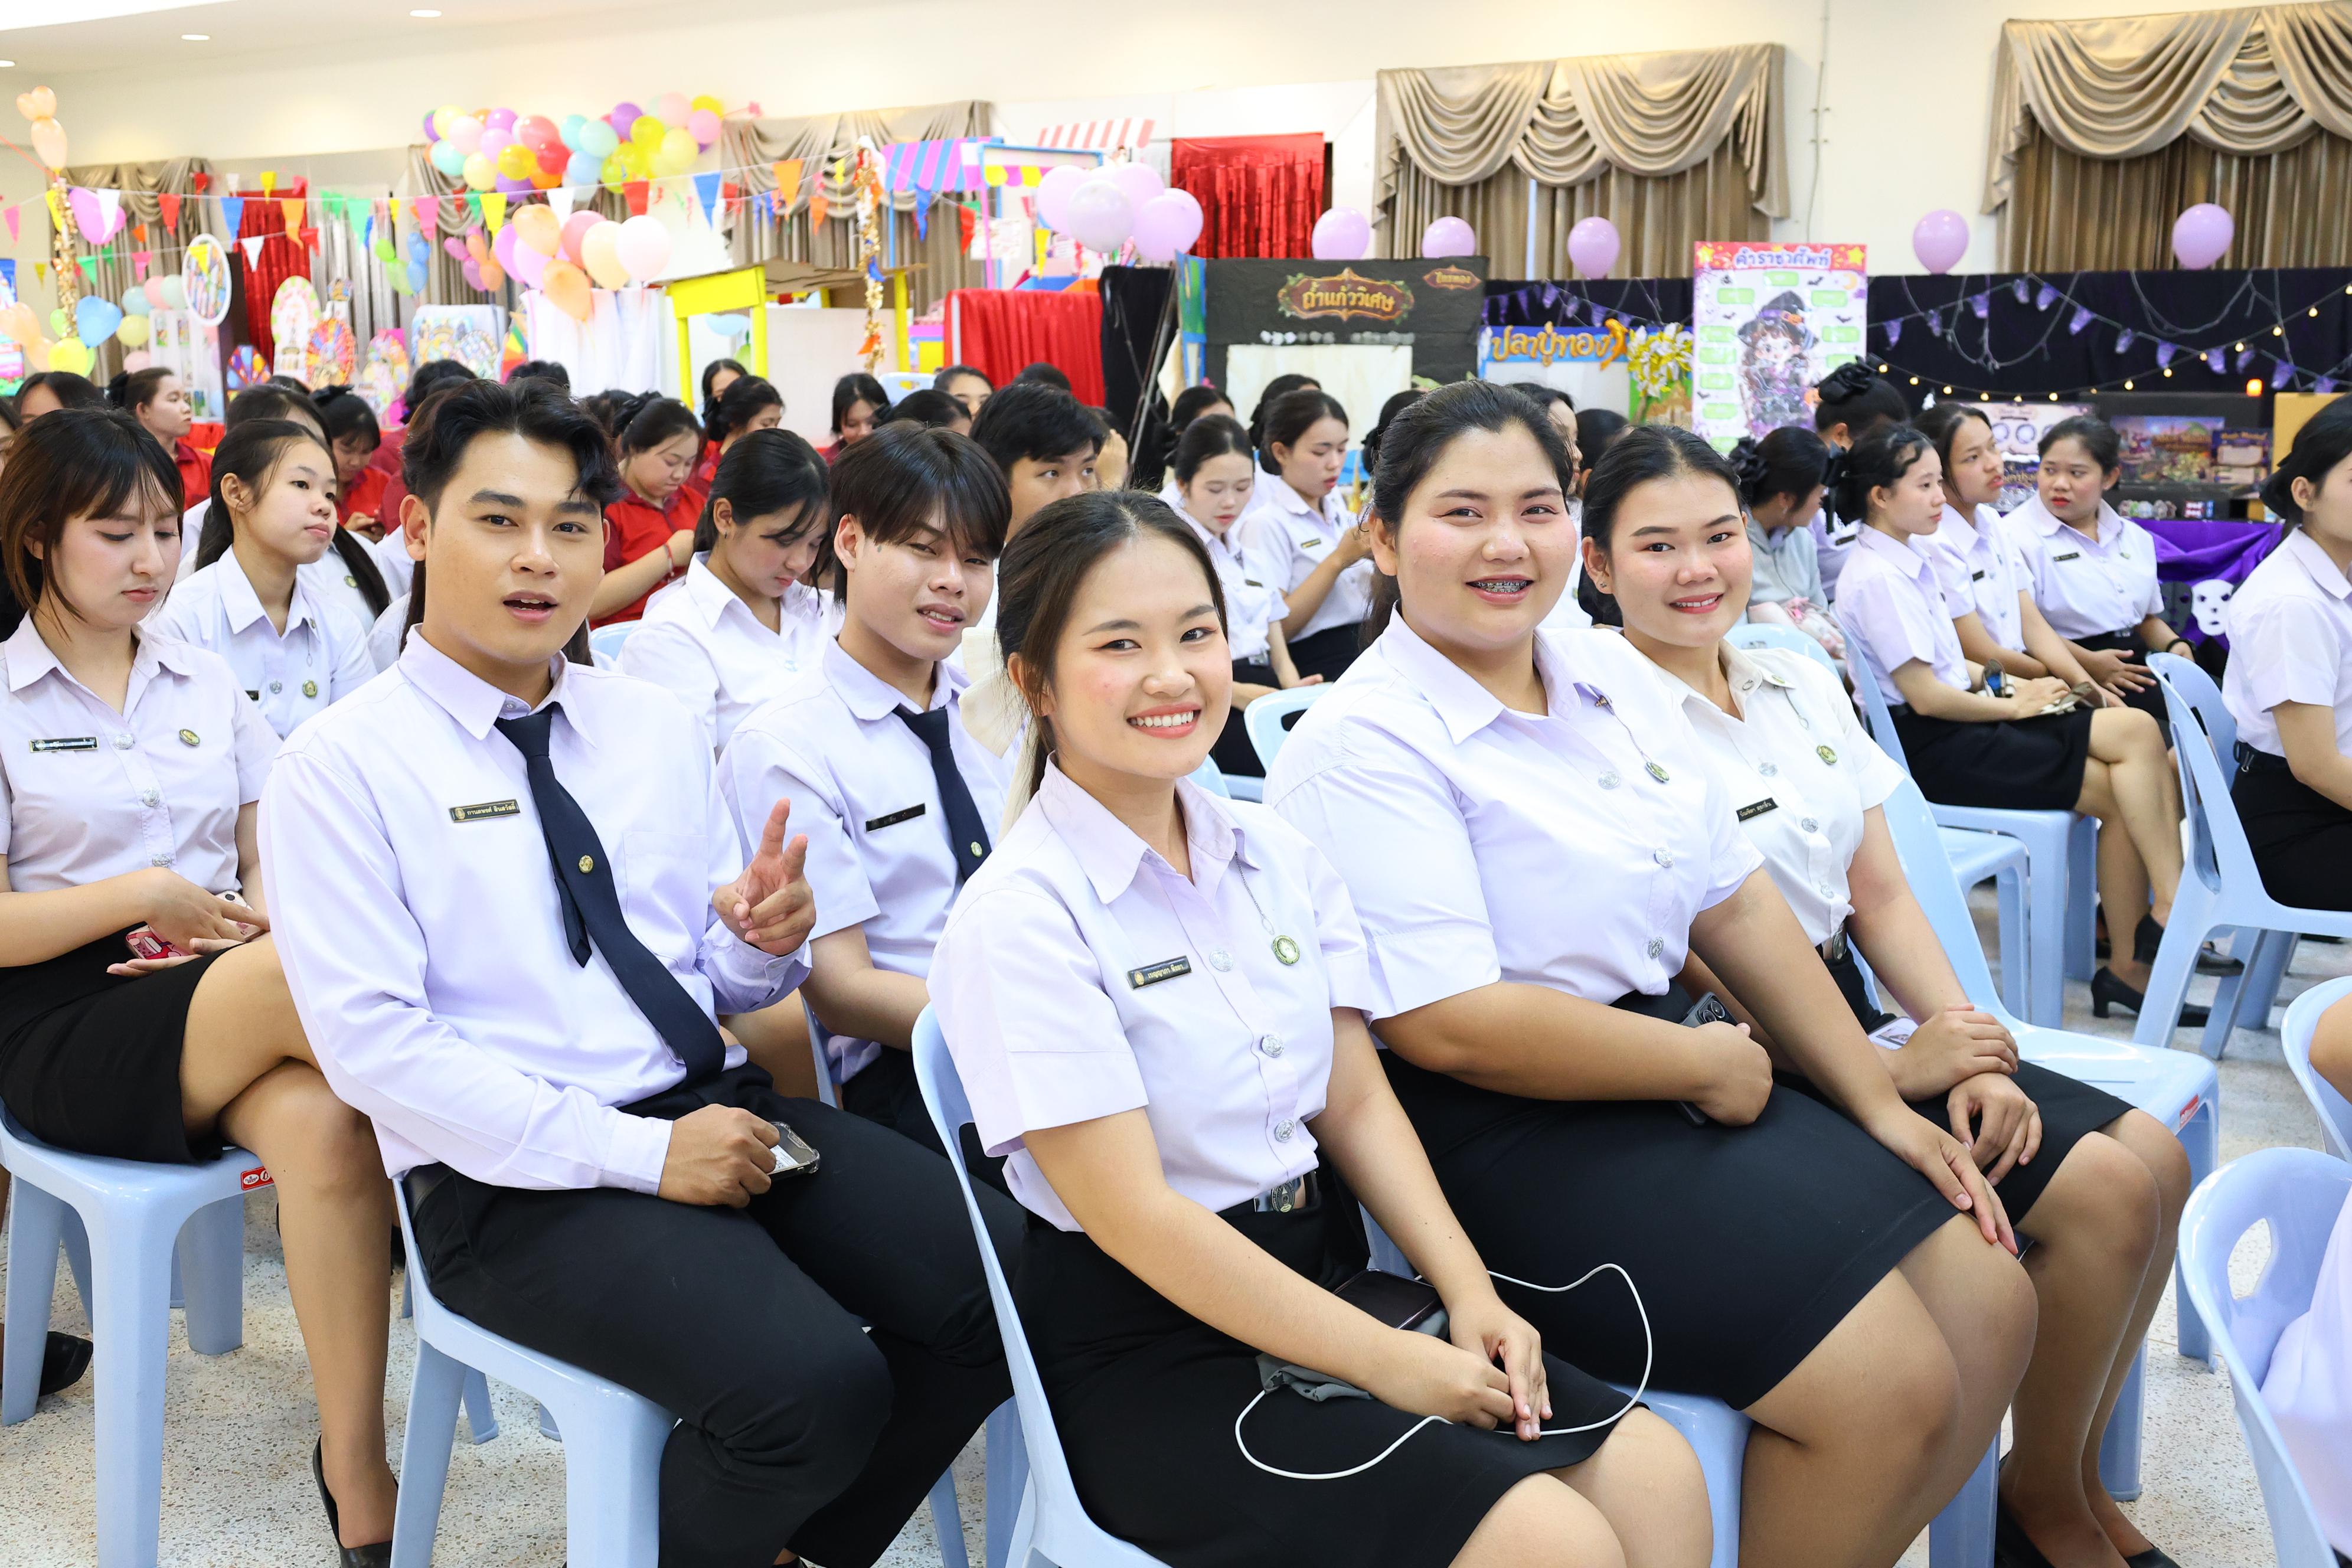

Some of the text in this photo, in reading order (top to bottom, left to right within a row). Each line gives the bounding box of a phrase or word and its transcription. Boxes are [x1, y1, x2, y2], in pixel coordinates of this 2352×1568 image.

[1736, 247, 1830, 265] คำราชาศัพท์
[1302, 281, 1395, 312] ถ้ำแก้ววิเศษ
[1491, 321, 1611, 367] ปลาบู่ทอง
